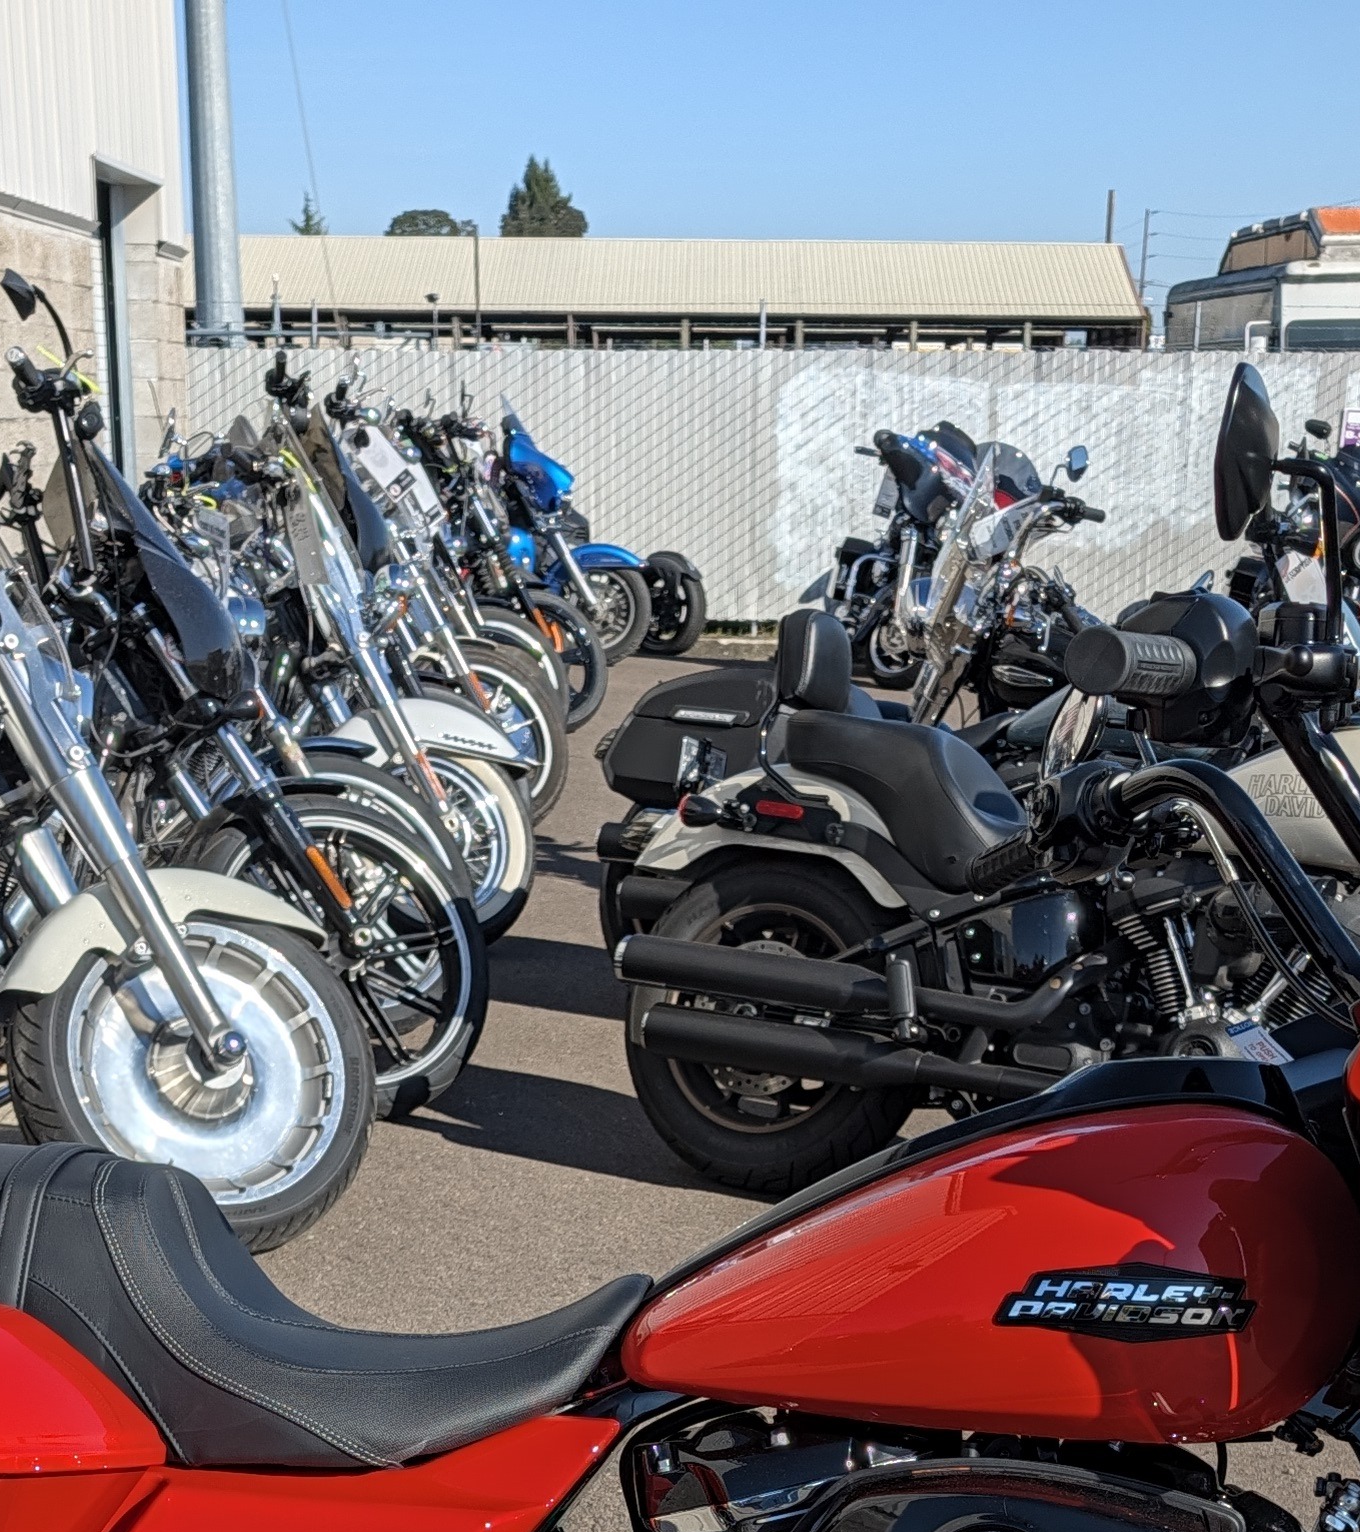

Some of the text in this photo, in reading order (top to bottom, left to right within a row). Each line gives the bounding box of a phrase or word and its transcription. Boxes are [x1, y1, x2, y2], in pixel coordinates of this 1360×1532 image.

[1248, 774, 1313, 799] HARL
[1265, 796, 1328, 819] DAVID
[1256, 1040, 1277, 1060] PUSH
[1007, 1300, 1245, 1326] DAVIDSON
